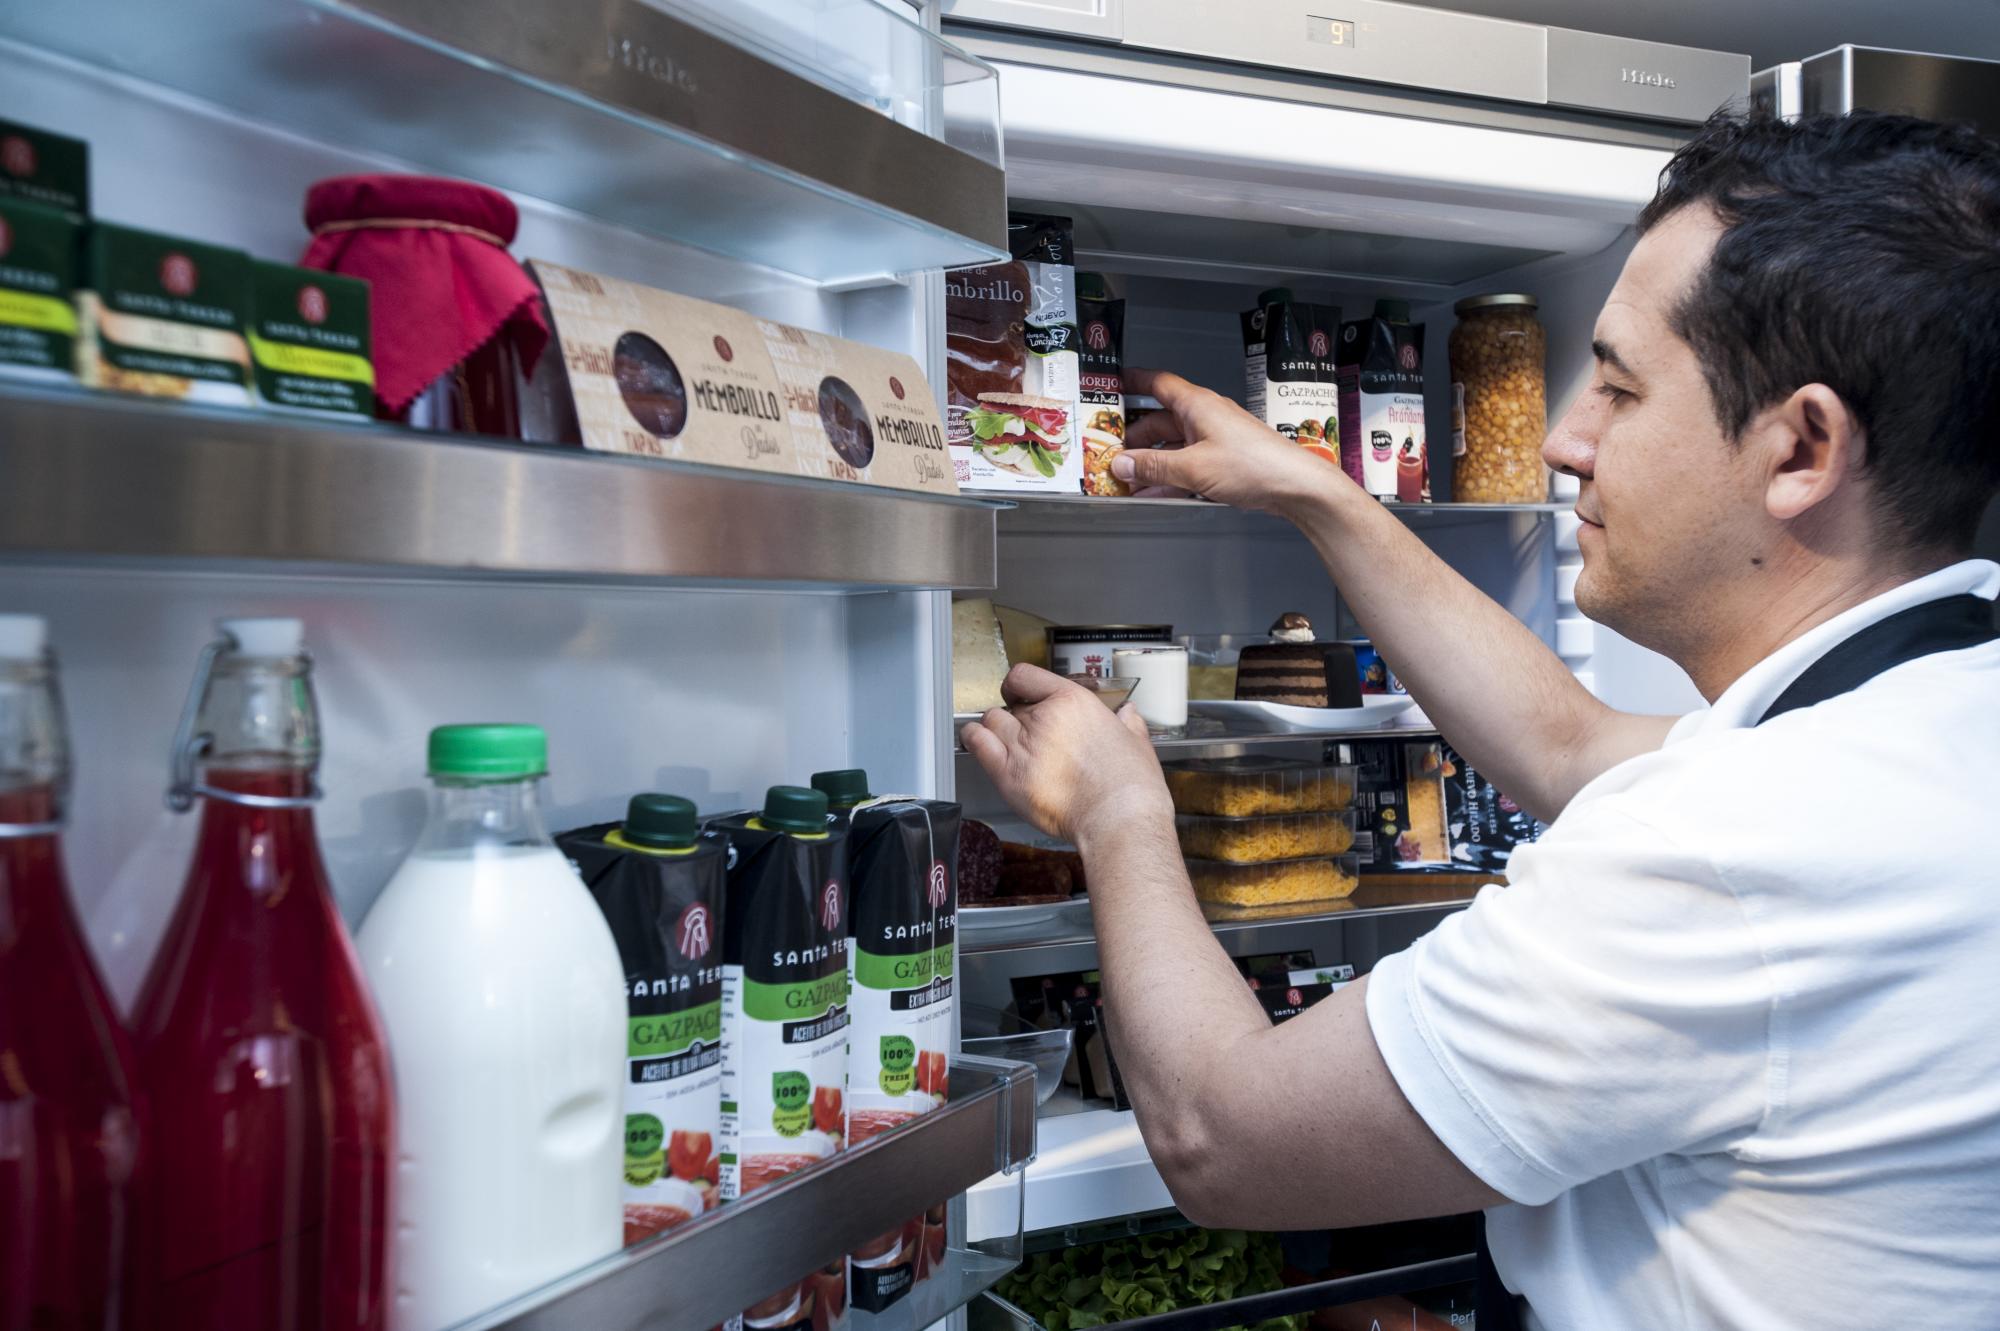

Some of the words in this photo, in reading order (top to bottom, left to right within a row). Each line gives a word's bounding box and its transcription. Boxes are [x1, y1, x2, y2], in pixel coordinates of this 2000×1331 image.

[1330, 22, 1344, 45] 9
[1035, 310, 1067, 322] NUEVO
[1081, 353, 1094, 363] TA
[1097, 354, 1119, 364] TER
[1281, 361, 1316, 371] SANTA
[691, 378, 780, 422] MEMBRILLO
[875, 413, 943, 451] MEMBRILLO
[1281, 431, 1298, 439] 00%
[828, 459, 858, 481] TAPAS
[1468, 801, 1481, 843] HILADO
[882, 920, 933, 940] SANTA
[772, 944, 828, 967] SANTA
[894, 948, 954, 979] GAZPAC
[784, 974, 848, 1009] GAZPAC
[633, 1008, 721, 1046] GAZPAC
[883, 1049, 914, 1060] 100%
[776, 1084, 808, 1098] 100%
